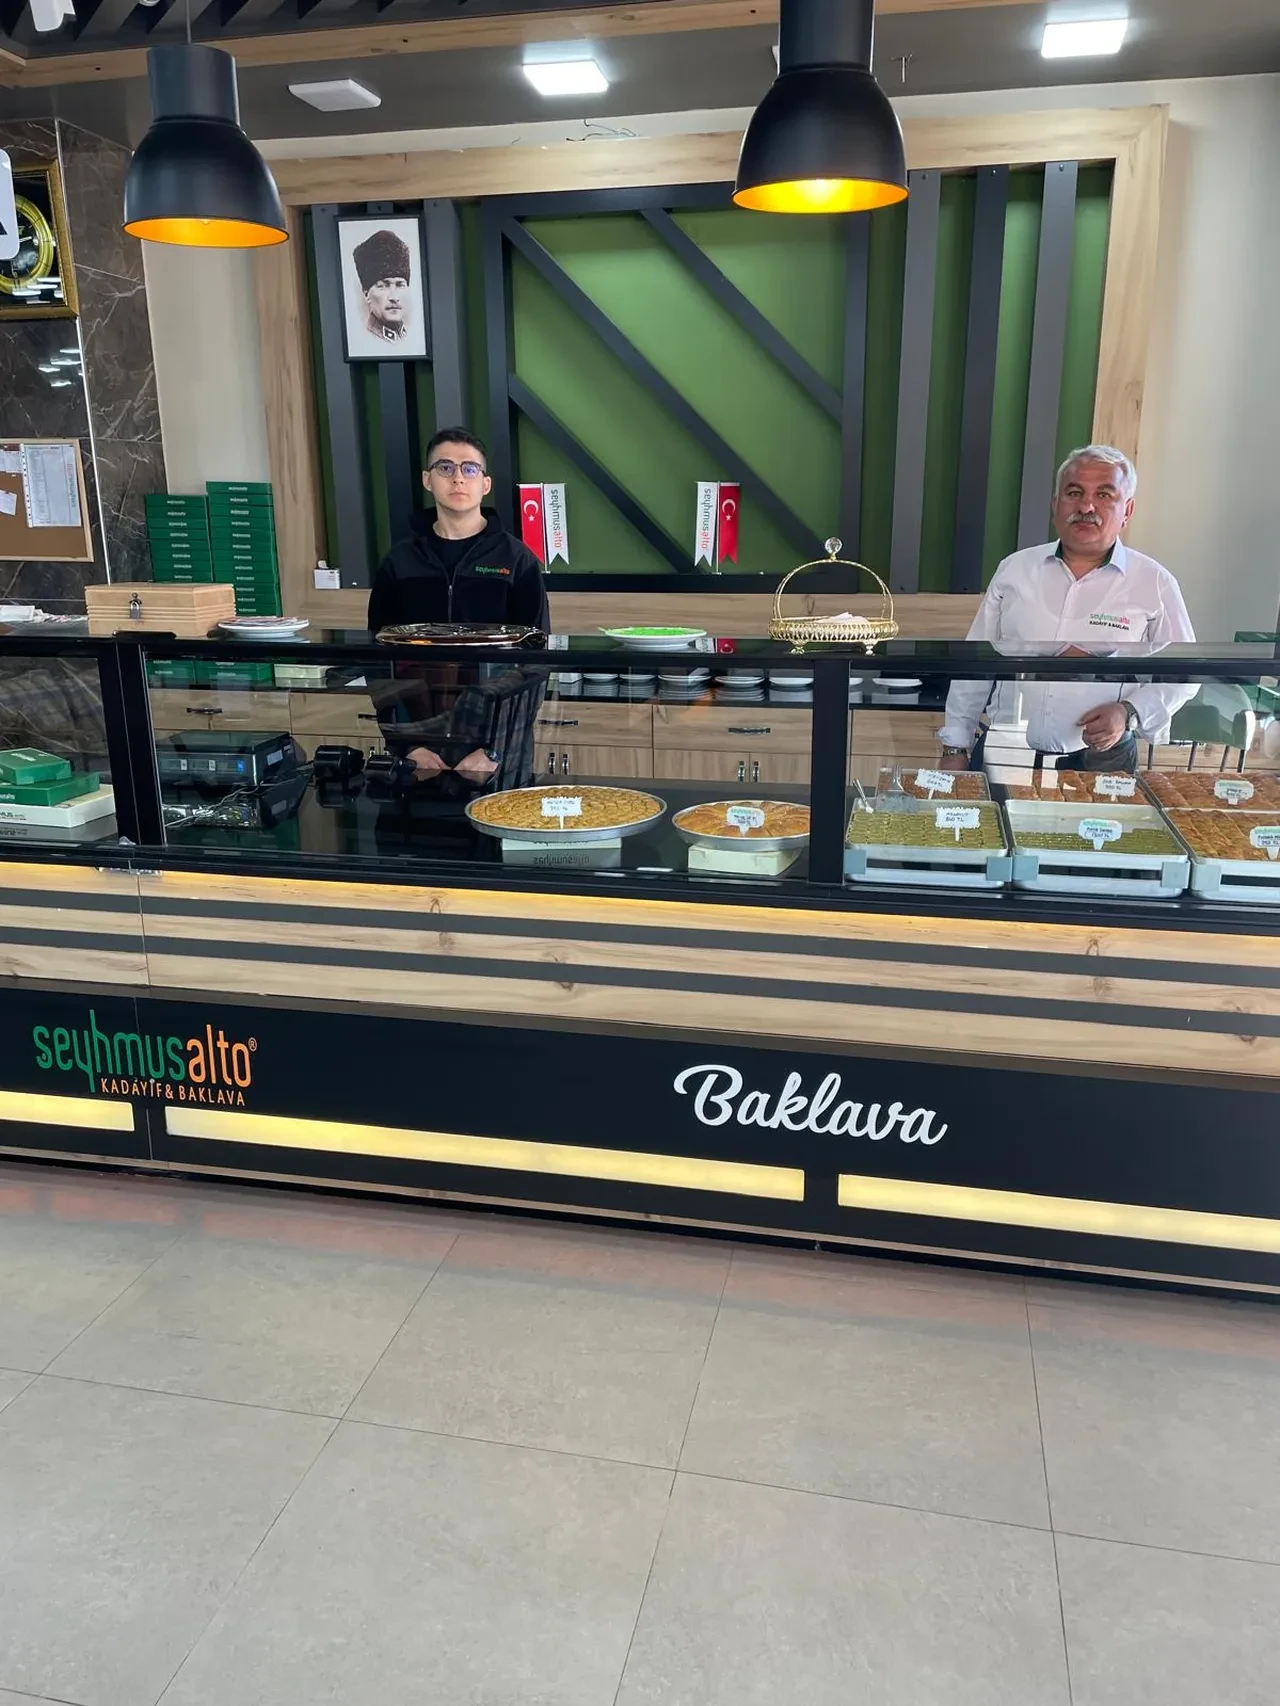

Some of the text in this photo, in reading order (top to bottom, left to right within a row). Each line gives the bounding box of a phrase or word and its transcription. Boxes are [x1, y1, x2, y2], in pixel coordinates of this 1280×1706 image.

[549, 488, 563, 549] seyhmusalto
[700, 487, 713, 550] seyhmusalto
[178, 1084, 246, 1107] BAKLAVA
[673, 1064, 948, 1146] Baklava
